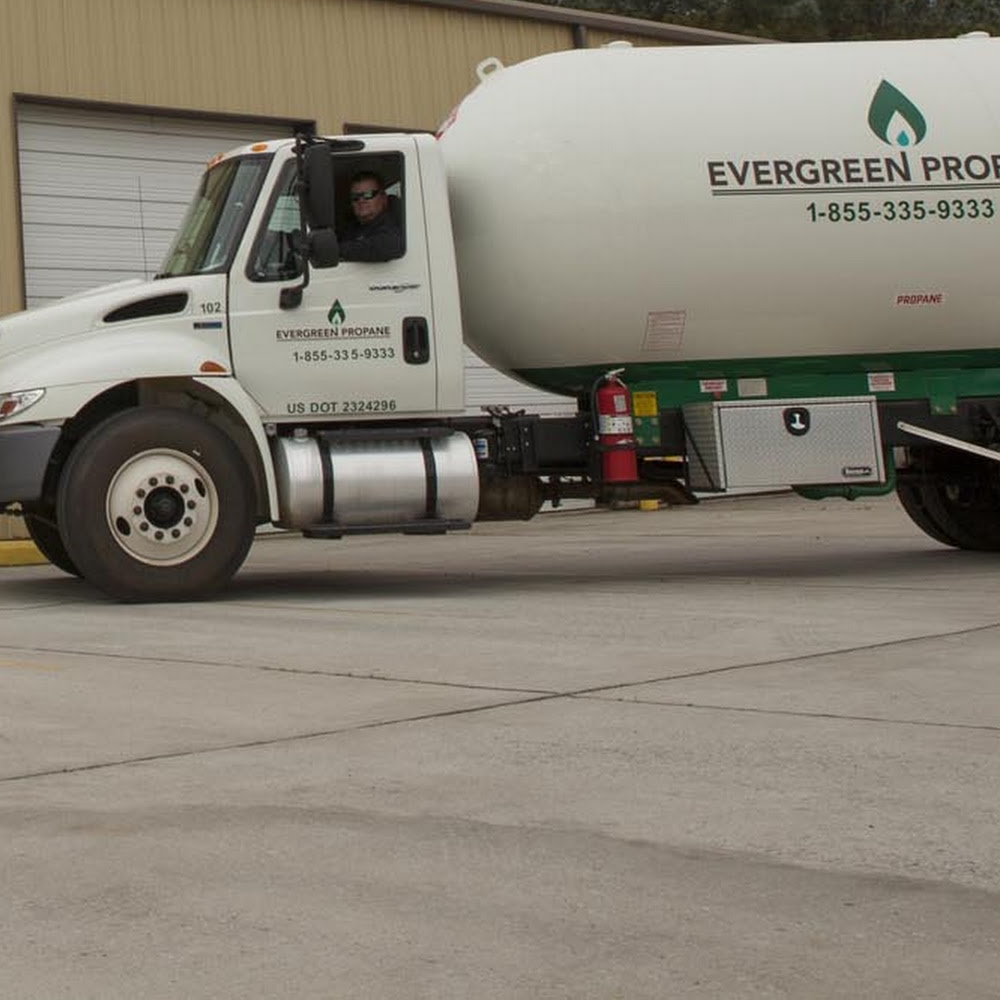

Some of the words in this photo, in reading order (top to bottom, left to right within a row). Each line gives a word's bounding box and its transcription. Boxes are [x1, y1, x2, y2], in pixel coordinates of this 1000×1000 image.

[707, 151, 911, 186] EVERGREEN
[806, 199, 994, 222] 1-855-335-9333
[896, 294, 943, 304] PROPANE
[200, 301, 222, 314] 102
[276, 325, 339, 339] EVERGREEN
[341, 326, 391, 336] PROPANE
[293, 347, 395, 362] 1-855-335-9333
[287, 403, 305, 414] US
[310, 402, 338, 413] DOT
[342, 400, 397, 413] 2324296
